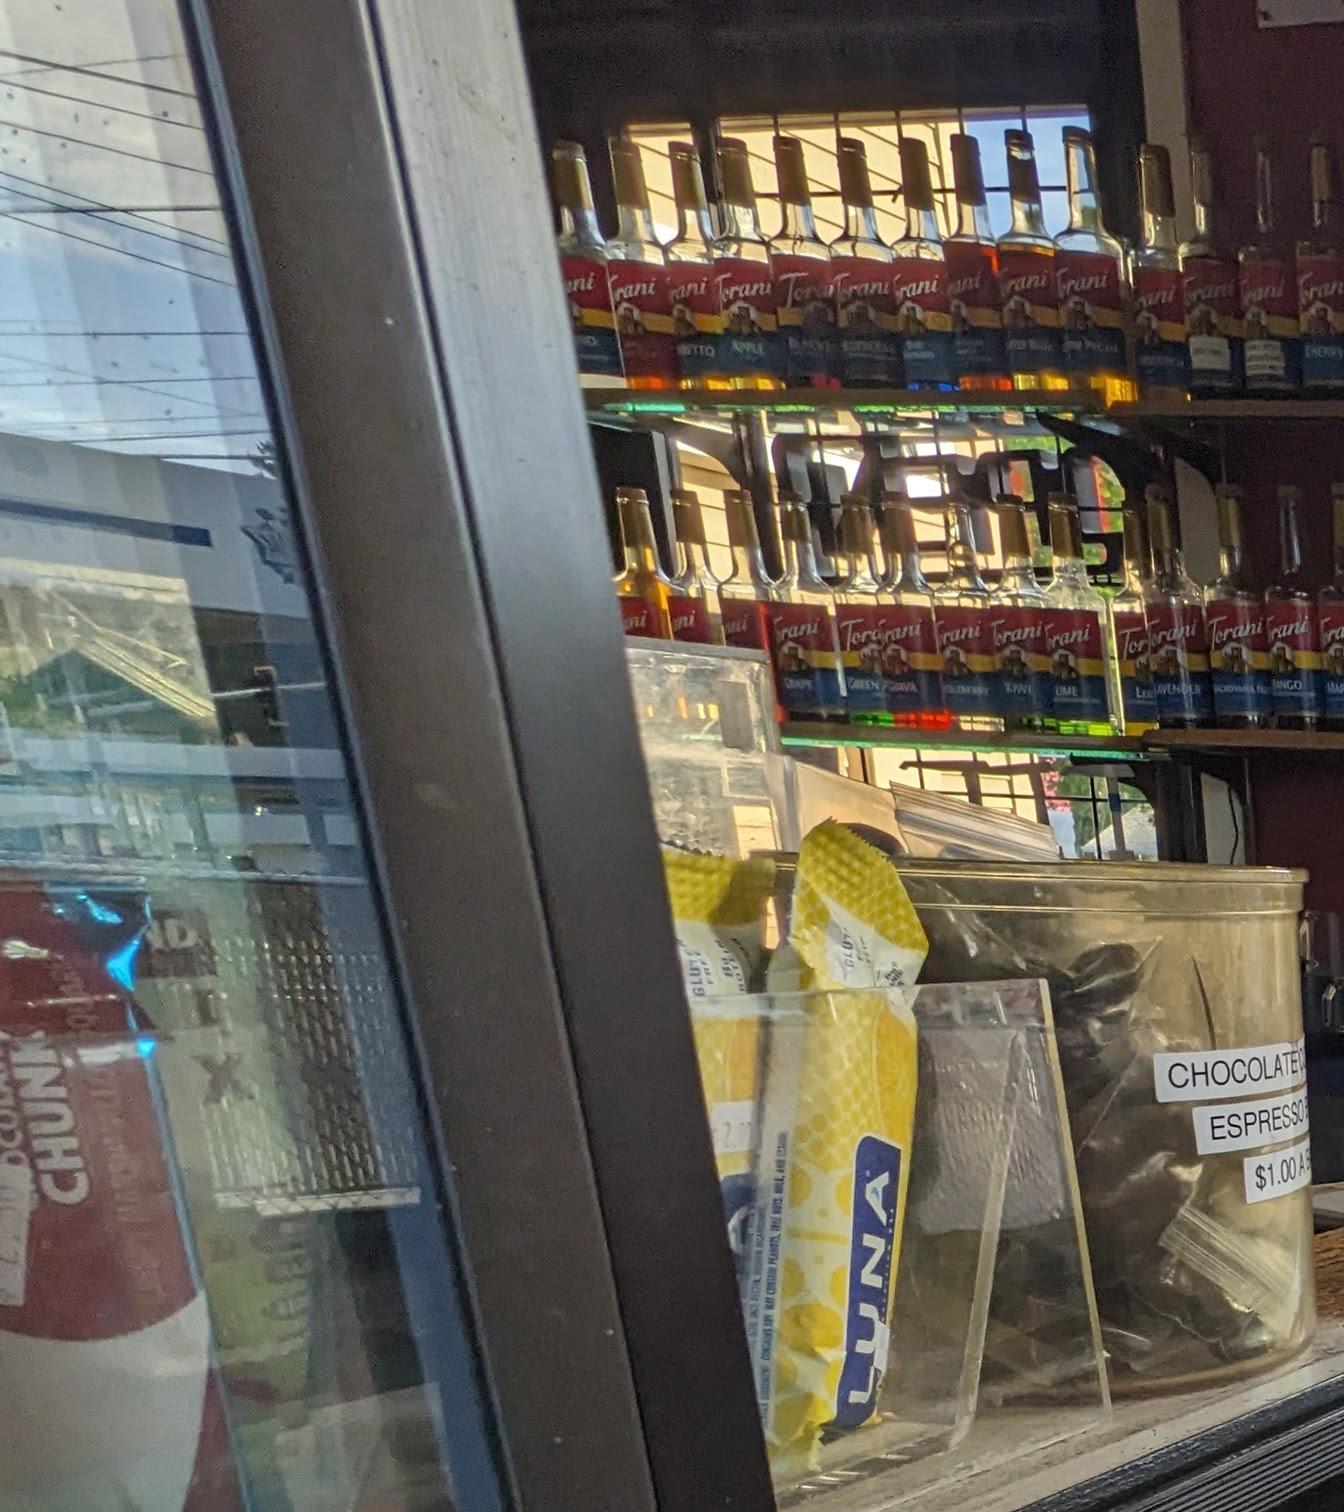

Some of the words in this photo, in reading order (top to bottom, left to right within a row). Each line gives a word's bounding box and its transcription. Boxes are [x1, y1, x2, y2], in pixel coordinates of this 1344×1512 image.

[1168, 1050, 1298, 1088] CHOCOLATE
[1210, 1099, 1304, 1140] ESPRESSO
[1254, 1157, 1297, 1192] $1.00
[848, 1171, 890, 1404] LUNA
